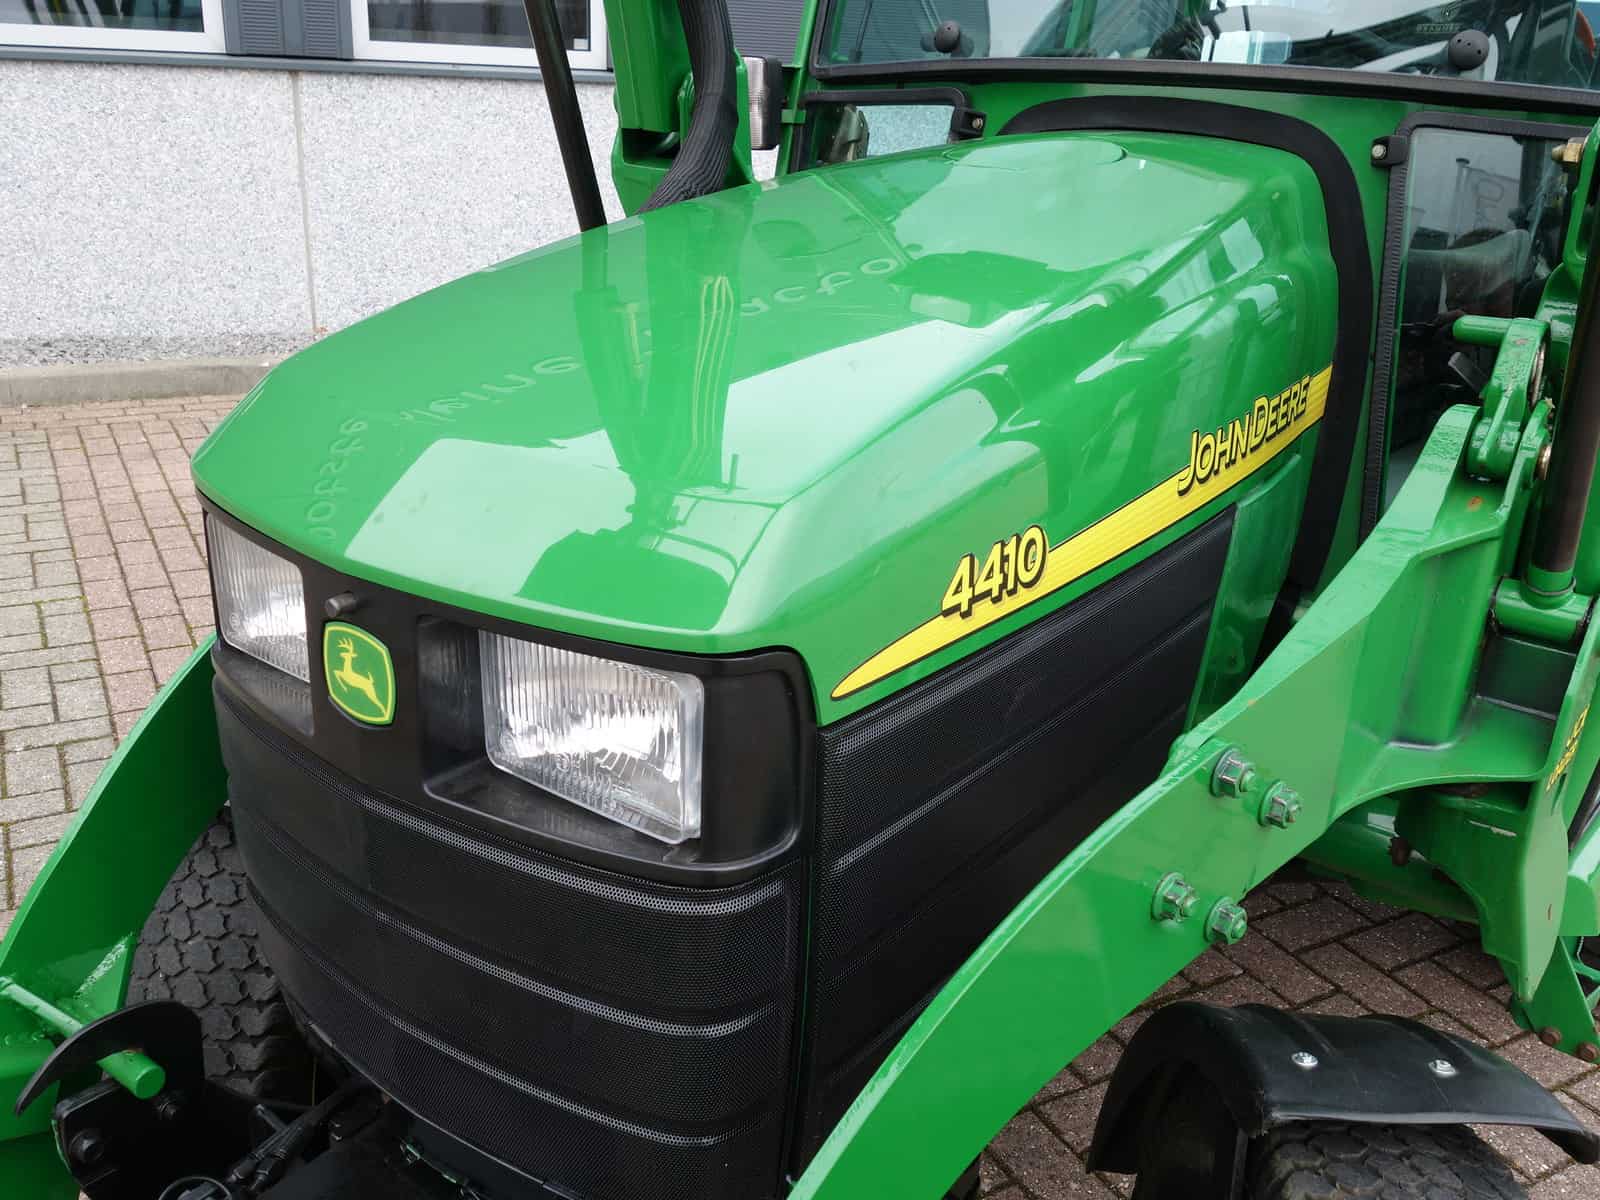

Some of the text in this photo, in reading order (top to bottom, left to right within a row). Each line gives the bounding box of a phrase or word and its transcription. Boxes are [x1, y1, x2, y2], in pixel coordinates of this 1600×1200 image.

[1177, 374, 1311, 496] JOHN DEERE
[941, 524, 1048, 619] 4410
